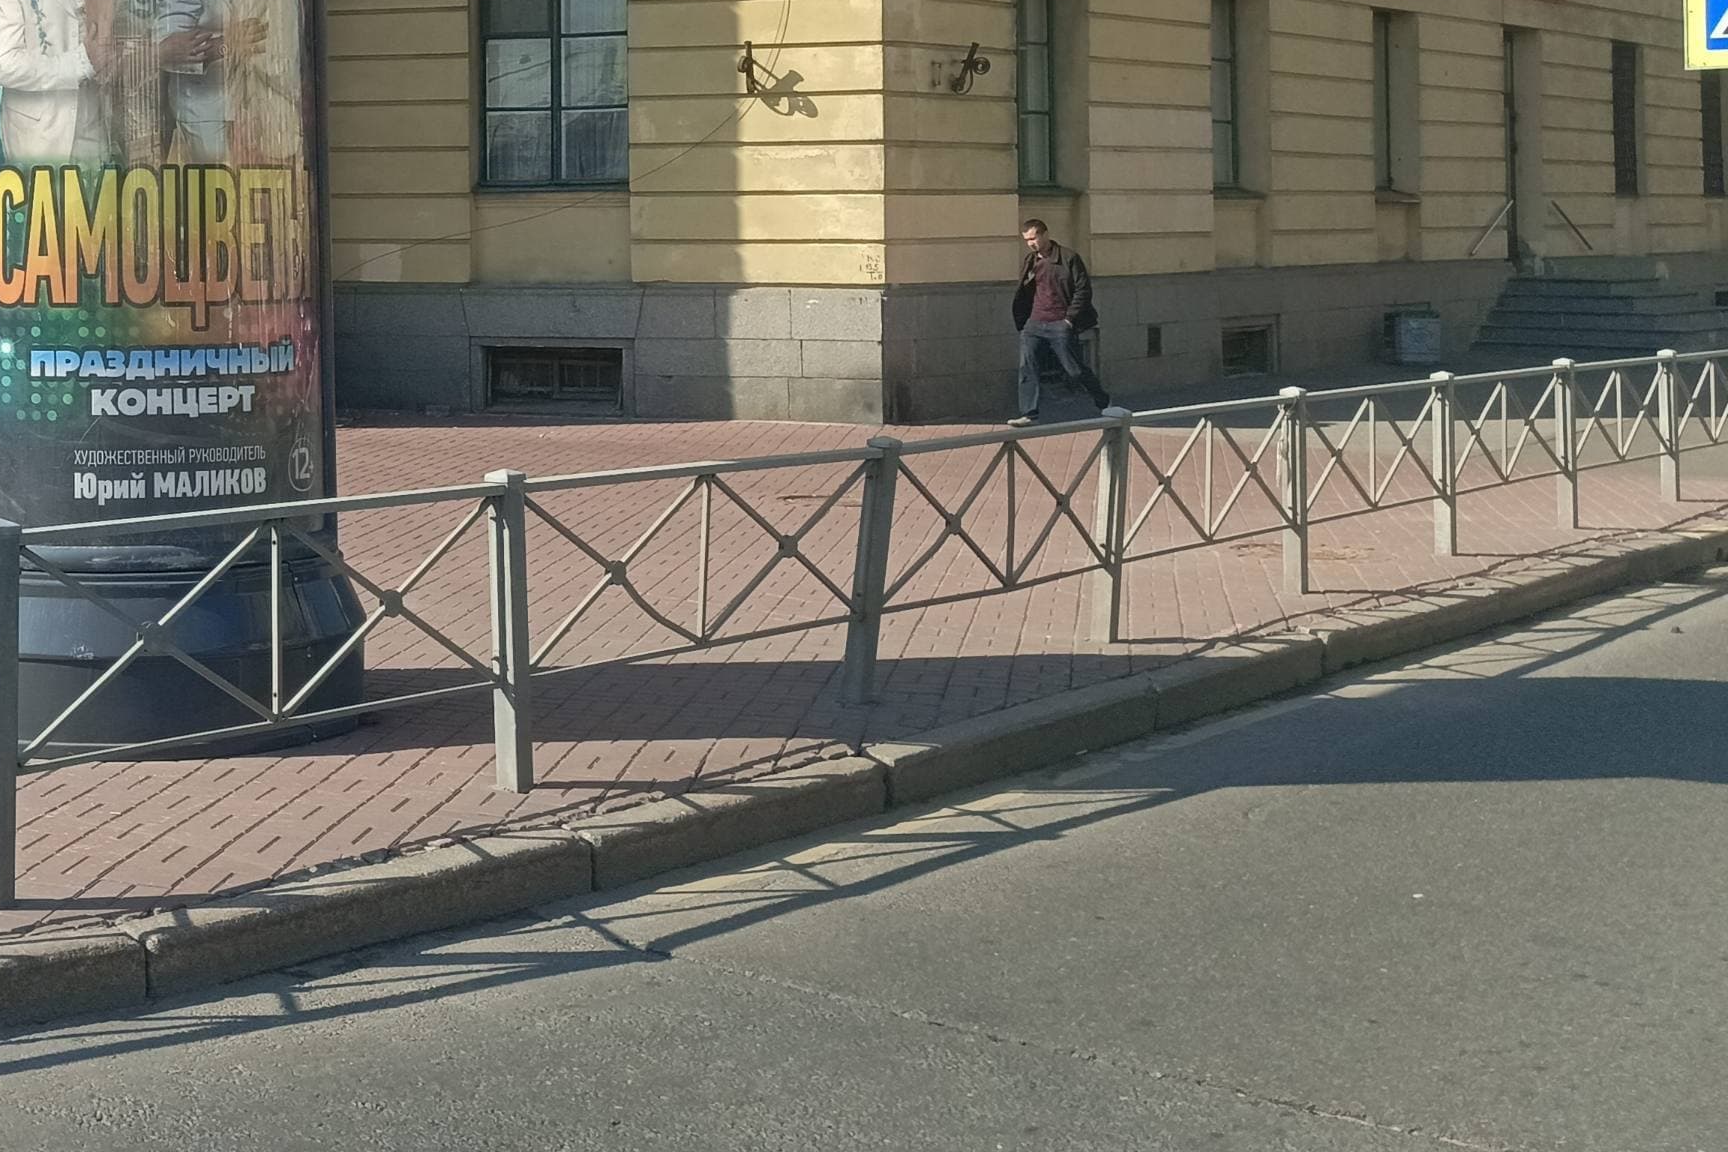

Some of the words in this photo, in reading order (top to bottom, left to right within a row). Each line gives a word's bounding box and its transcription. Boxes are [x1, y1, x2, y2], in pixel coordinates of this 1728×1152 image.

[30, 340, 294, 380] ПРАЗДНИЧНЫЙ
[91, 385, 255, 418] КОНЦЕРТ
[74, 446, 185, 467] ХУДОЖЕСТВЕННЫЙ
[189, 444, 266, 464] РУКОВОДИТЕЛЬ
[74, 472, 146, 506] Юрий
[154, 466, 267, 498] МАЛИКОВ
